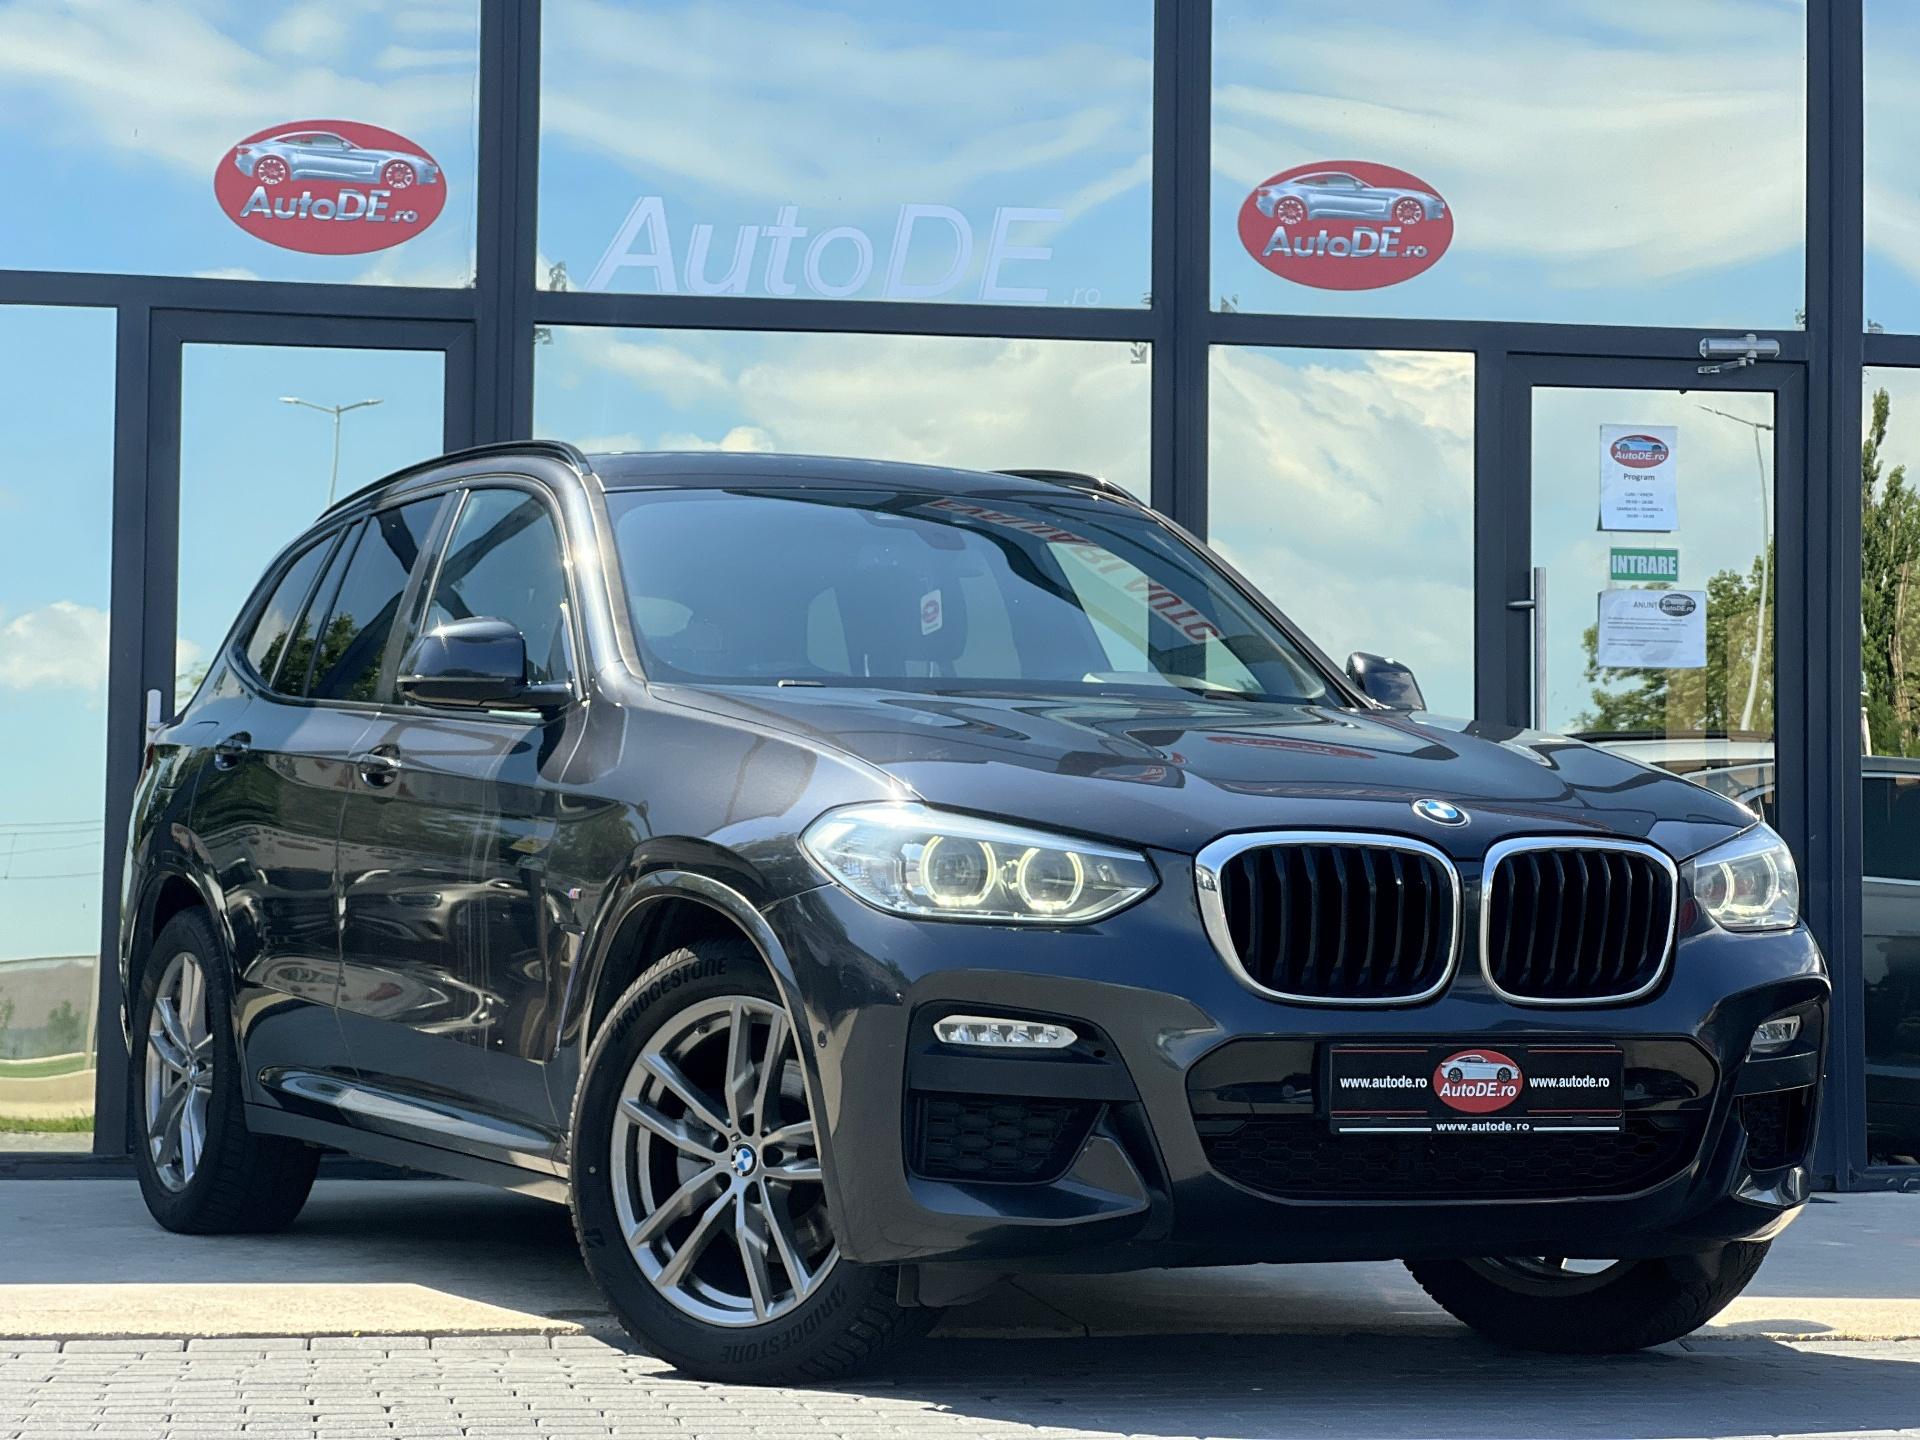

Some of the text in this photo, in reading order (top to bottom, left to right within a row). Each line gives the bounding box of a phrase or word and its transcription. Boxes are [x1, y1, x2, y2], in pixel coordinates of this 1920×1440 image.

[1623, 473, 1656, 482] Program
[1611, 554, 1677, 575] INTRARE
[1340, 1075, 1428, 1088] www.autode.ro
[1529, 1074, 1610, 1088] www.autode.ro
[1439, 1082, 1517, 1098] AutoDE.ro
[1435, 1121, 1530, 1131] www.autode.ro
